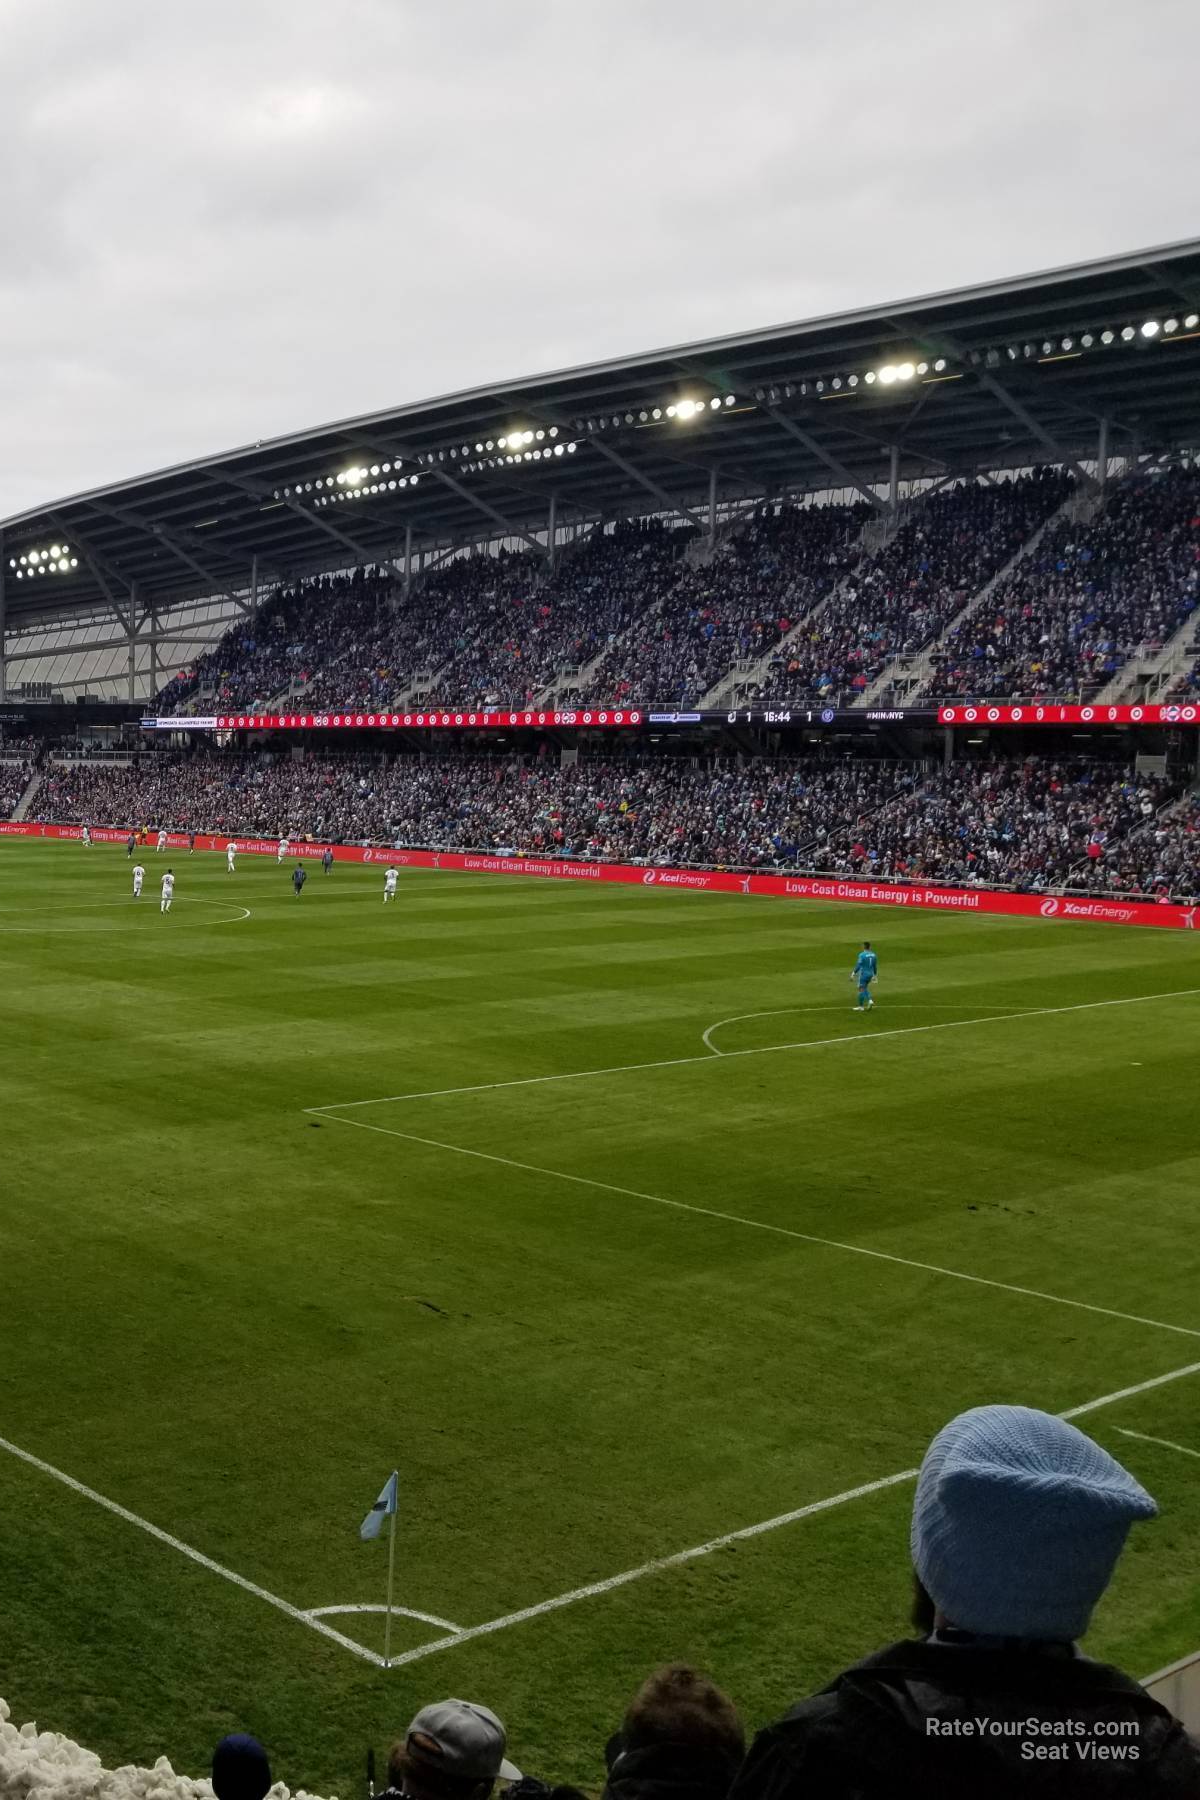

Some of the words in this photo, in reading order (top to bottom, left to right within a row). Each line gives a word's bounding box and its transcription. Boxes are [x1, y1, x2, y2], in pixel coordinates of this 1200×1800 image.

[746, 711, 752, 722] 1
[763, 711, 790, 722] 16:44
[806, 711, 812, 722] 1
[464, 858, 500, 869] Low-Cost
[502, 860, 523, 871] Clean
[525, 861, 551, 875] Energy
[553, 863, 561, 873] is
[562, 864, 600, 877] Powerful
[785, 881, 835, 895] Low-Cost
[838, 884, 868, 898] Clean
[871, 887, 909, 904] Energy
[912, 890, 922, 902] is
[925, 892, 979, 907] Powerful
